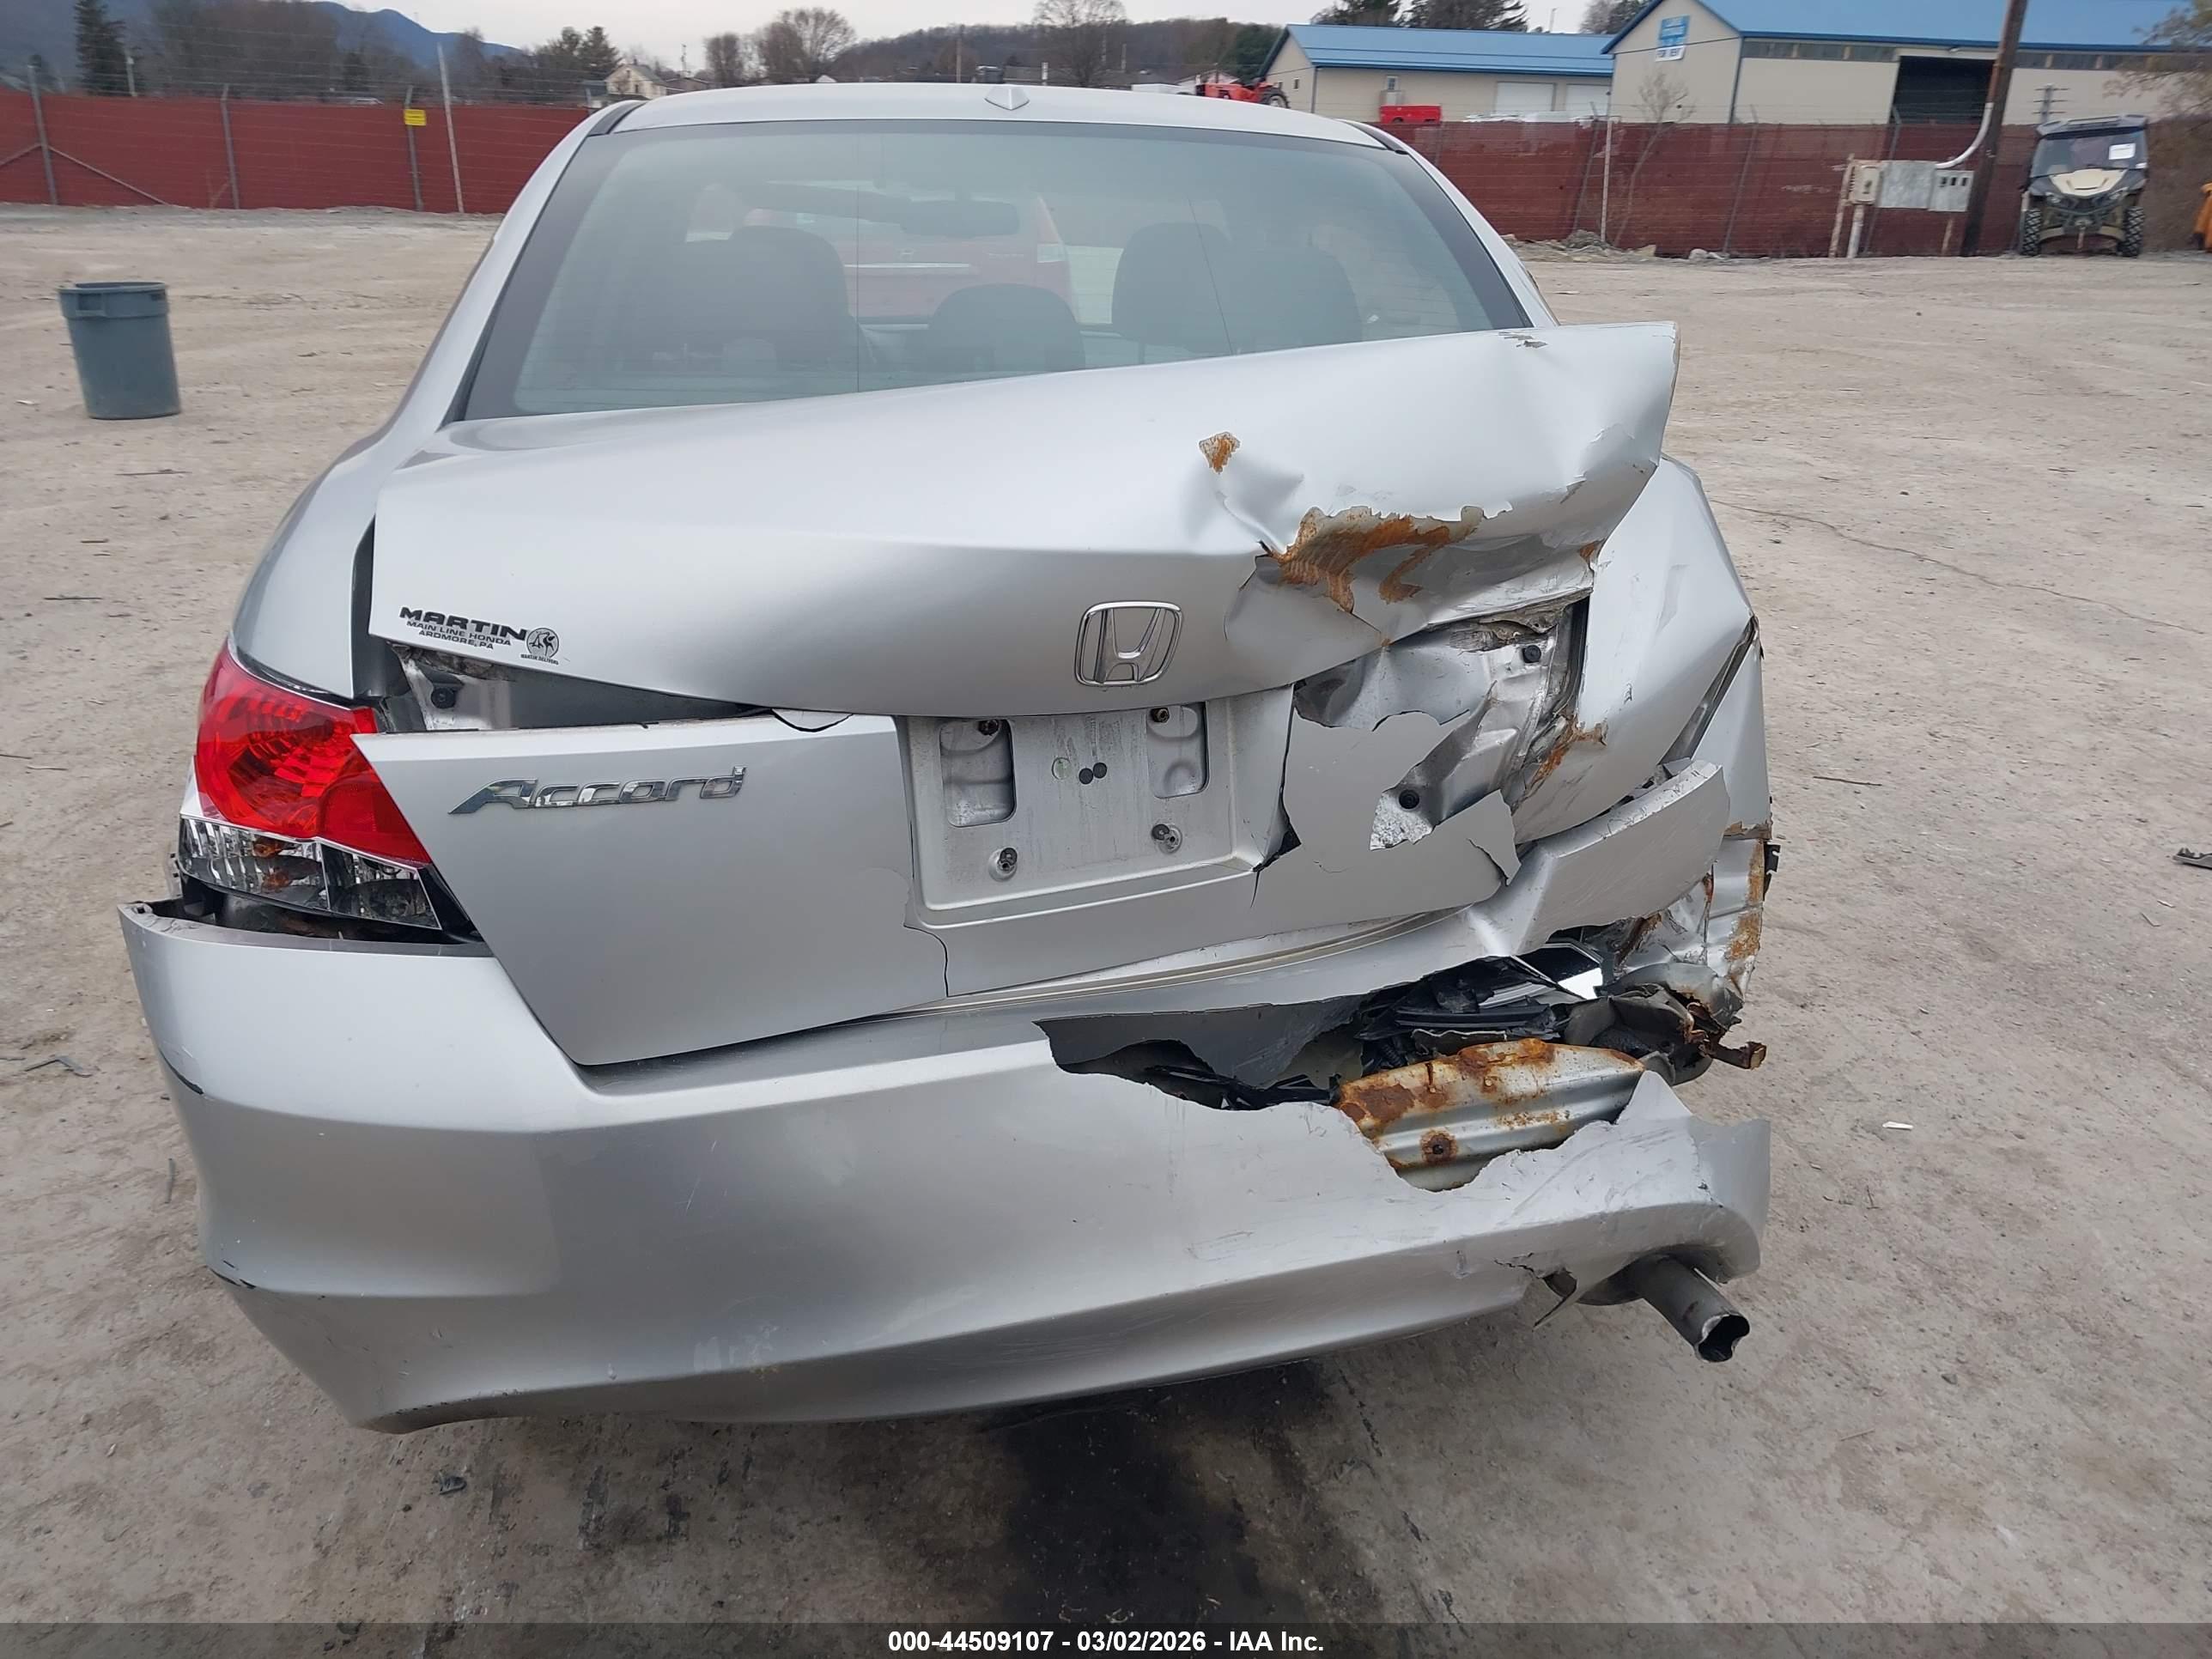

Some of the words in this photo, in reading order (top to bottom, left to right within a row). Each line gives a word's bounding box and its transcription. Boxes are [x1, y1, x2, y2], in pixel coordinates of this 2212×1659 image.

[399, 607, 527, 641] MARTIN
[406, 621, 436, 630] MAIN
[440, 627, 465, 636] LINE
[469, 633, 511, 646] HONDA
[447, 766, 747, 814] Accord
